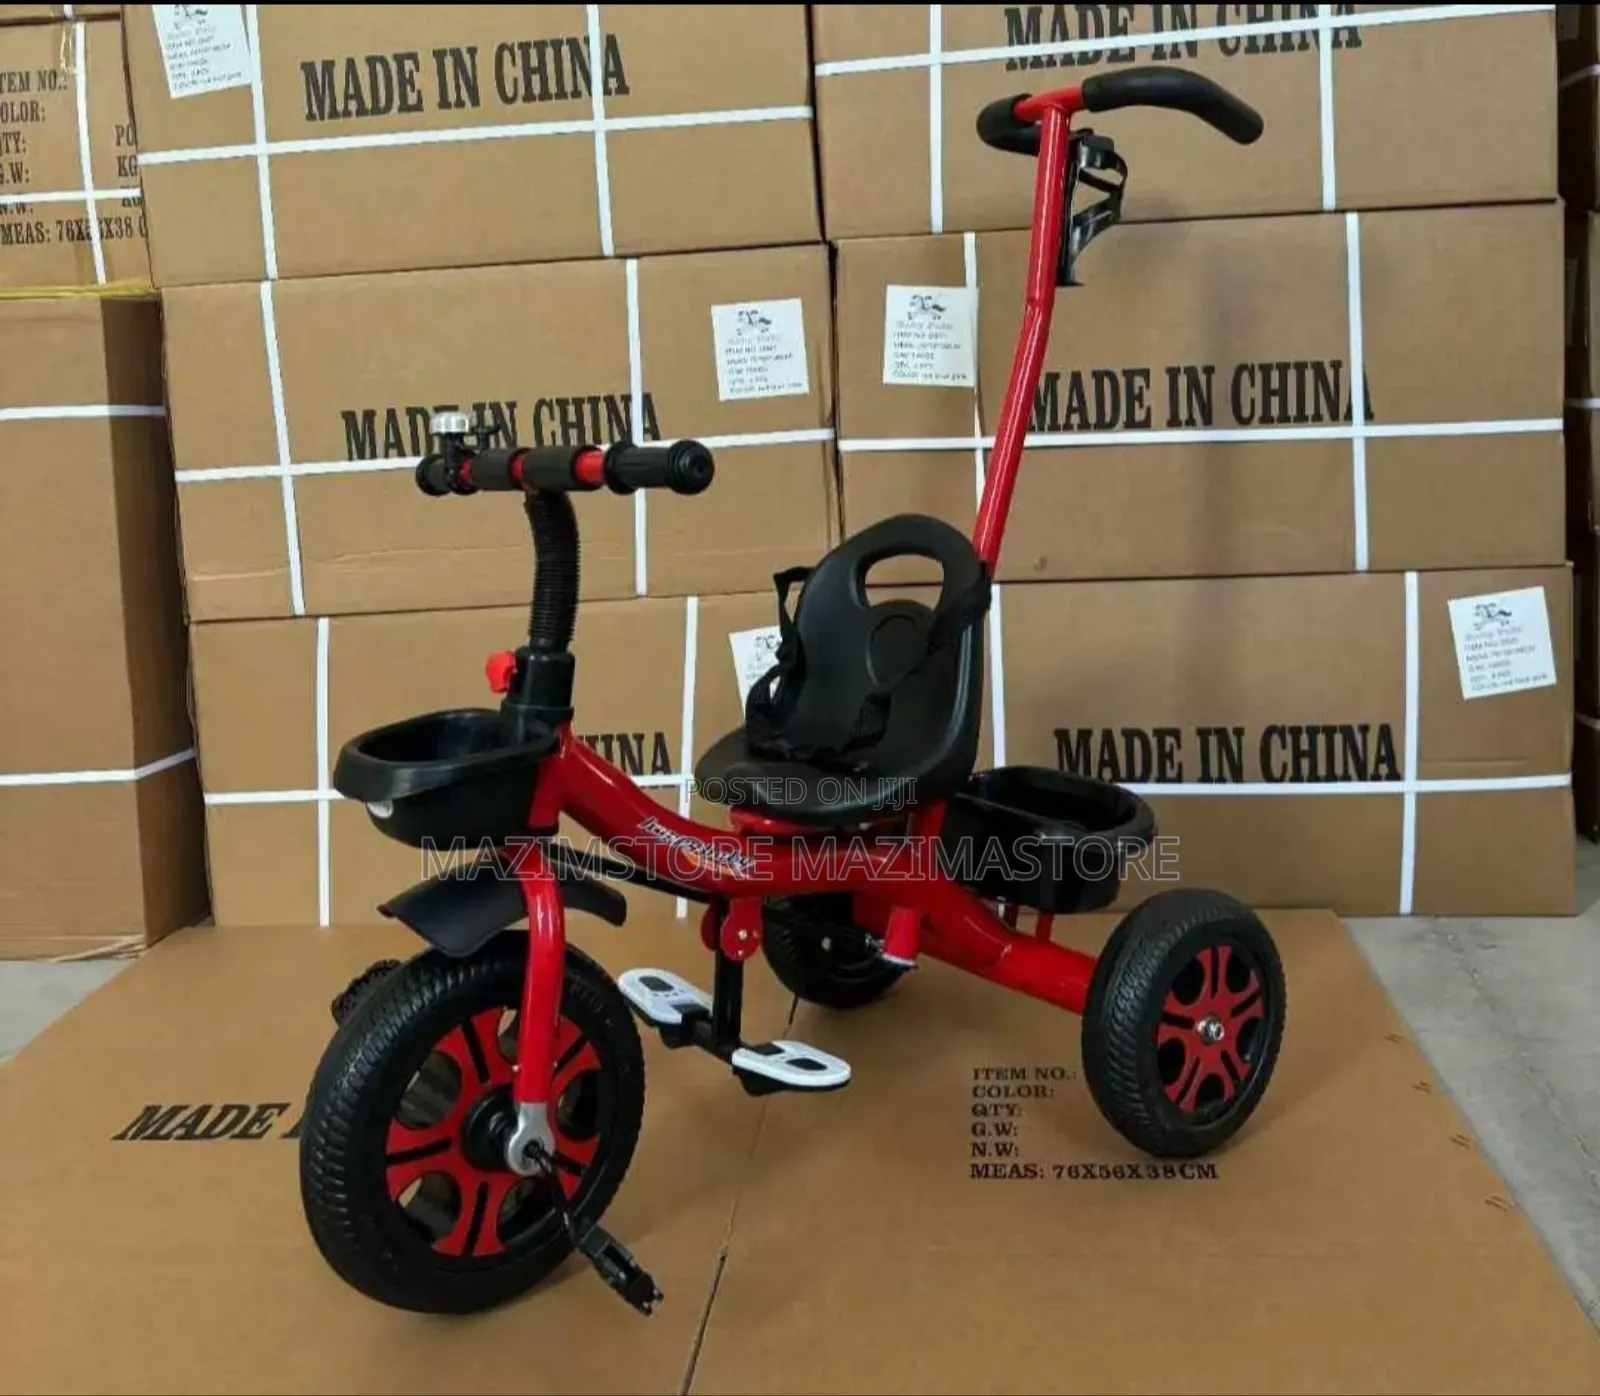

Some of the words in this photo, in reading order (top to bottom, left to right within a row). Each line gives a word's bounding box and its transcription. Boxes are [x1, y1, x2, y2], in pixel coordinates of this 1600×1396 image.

[1004, 4, 1136, 71] MADE
[1150, 4, 1198, 61] IN
[301, 51, 424, 121] MADE
[432, 46, 481, 110] IN
[494, 33, 630, 105] CHINA
[0, 131, 27, 157] TY:
[1029, 367, 1151, 431] MADE
[1165, 363, 1215, 428] IN
[340, 404, 459, 461] MAD
[533, 392, 661, 448] CHINA
[1054, 727, 1183, 784] MADE
[1196, 727, 1245, 784] IN
[1259, 723, 1402, 783] CHINA
[972, 1067, 1032, 1081] ITEM
[972, 1084, 1054, 1099] COLOR:
[111, 1102, 292, 1141] MADE
[971, 1103, 1023, 1118] QTY:
[970, 1163, 1045, 1179] MEAS:
